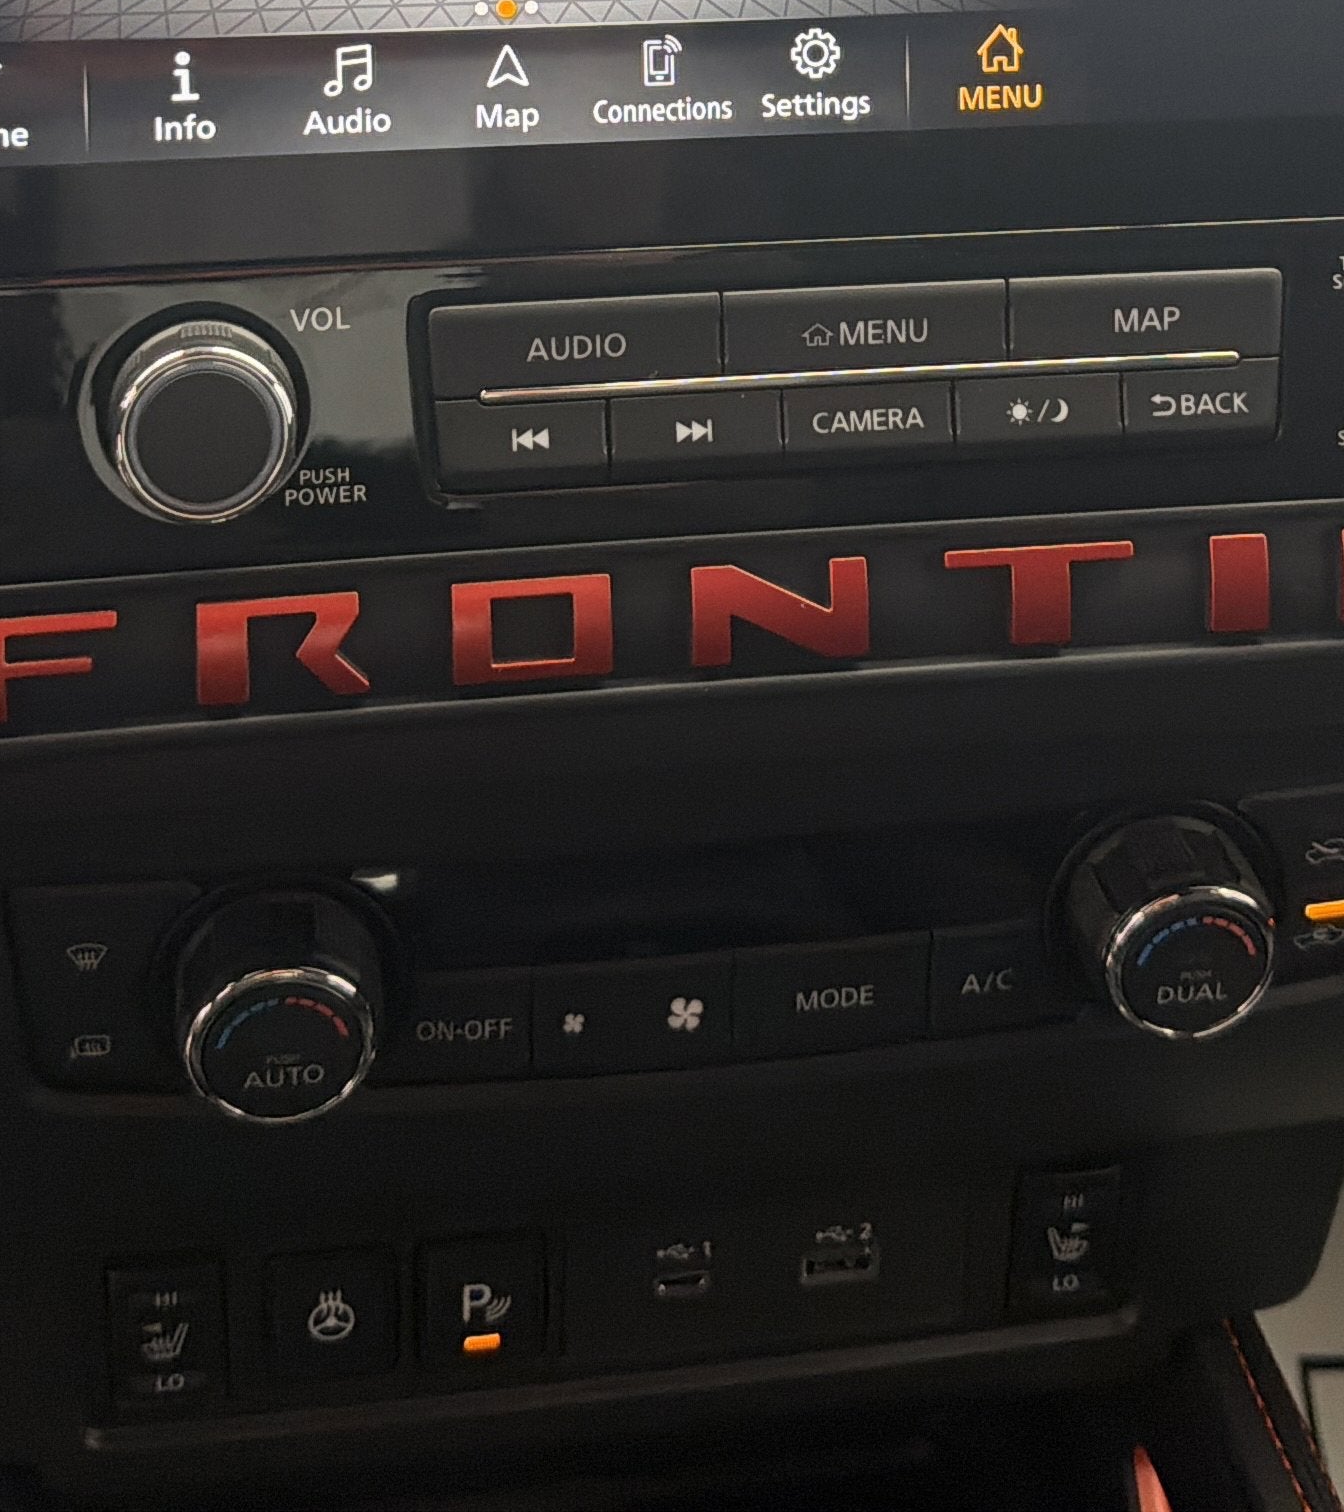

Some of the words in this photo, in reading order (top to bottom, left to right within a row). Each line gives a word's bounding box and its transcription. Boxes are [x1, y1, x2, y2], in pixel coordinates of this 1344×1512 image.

[593, 96, 733, 123] Connections
[761, 91, 871, 119] Settings
[959, 84, 1043, 111] MENU
[154, 114, 217, 142] Info
[303, 108, 392, 136] Audio
[475, 104, 540, 132] Map
[290, 306, 351, 331] VOL
[838, 318, 929, 345] MENU
[1113, 306, 1181, 334] MAP
[526, 332, 627, 363] AUDIO
[1180, 392, 1249, 416] BACK
[812, 406, 925, 435] CAMERA
[299, 467, 351, 485] PUSH
[285, 485, 367, 506] POWER
[960, 968, 1015, 996] A/C
[1156, 981, 1228, 1005] DUAL
[794, 984, 876, 1013] MODE
[416, 1018, 513, 1043] ON-OFF
[243, 1062, 325, 1089] AUTO
[155, 1373, 185, 1392] LO
